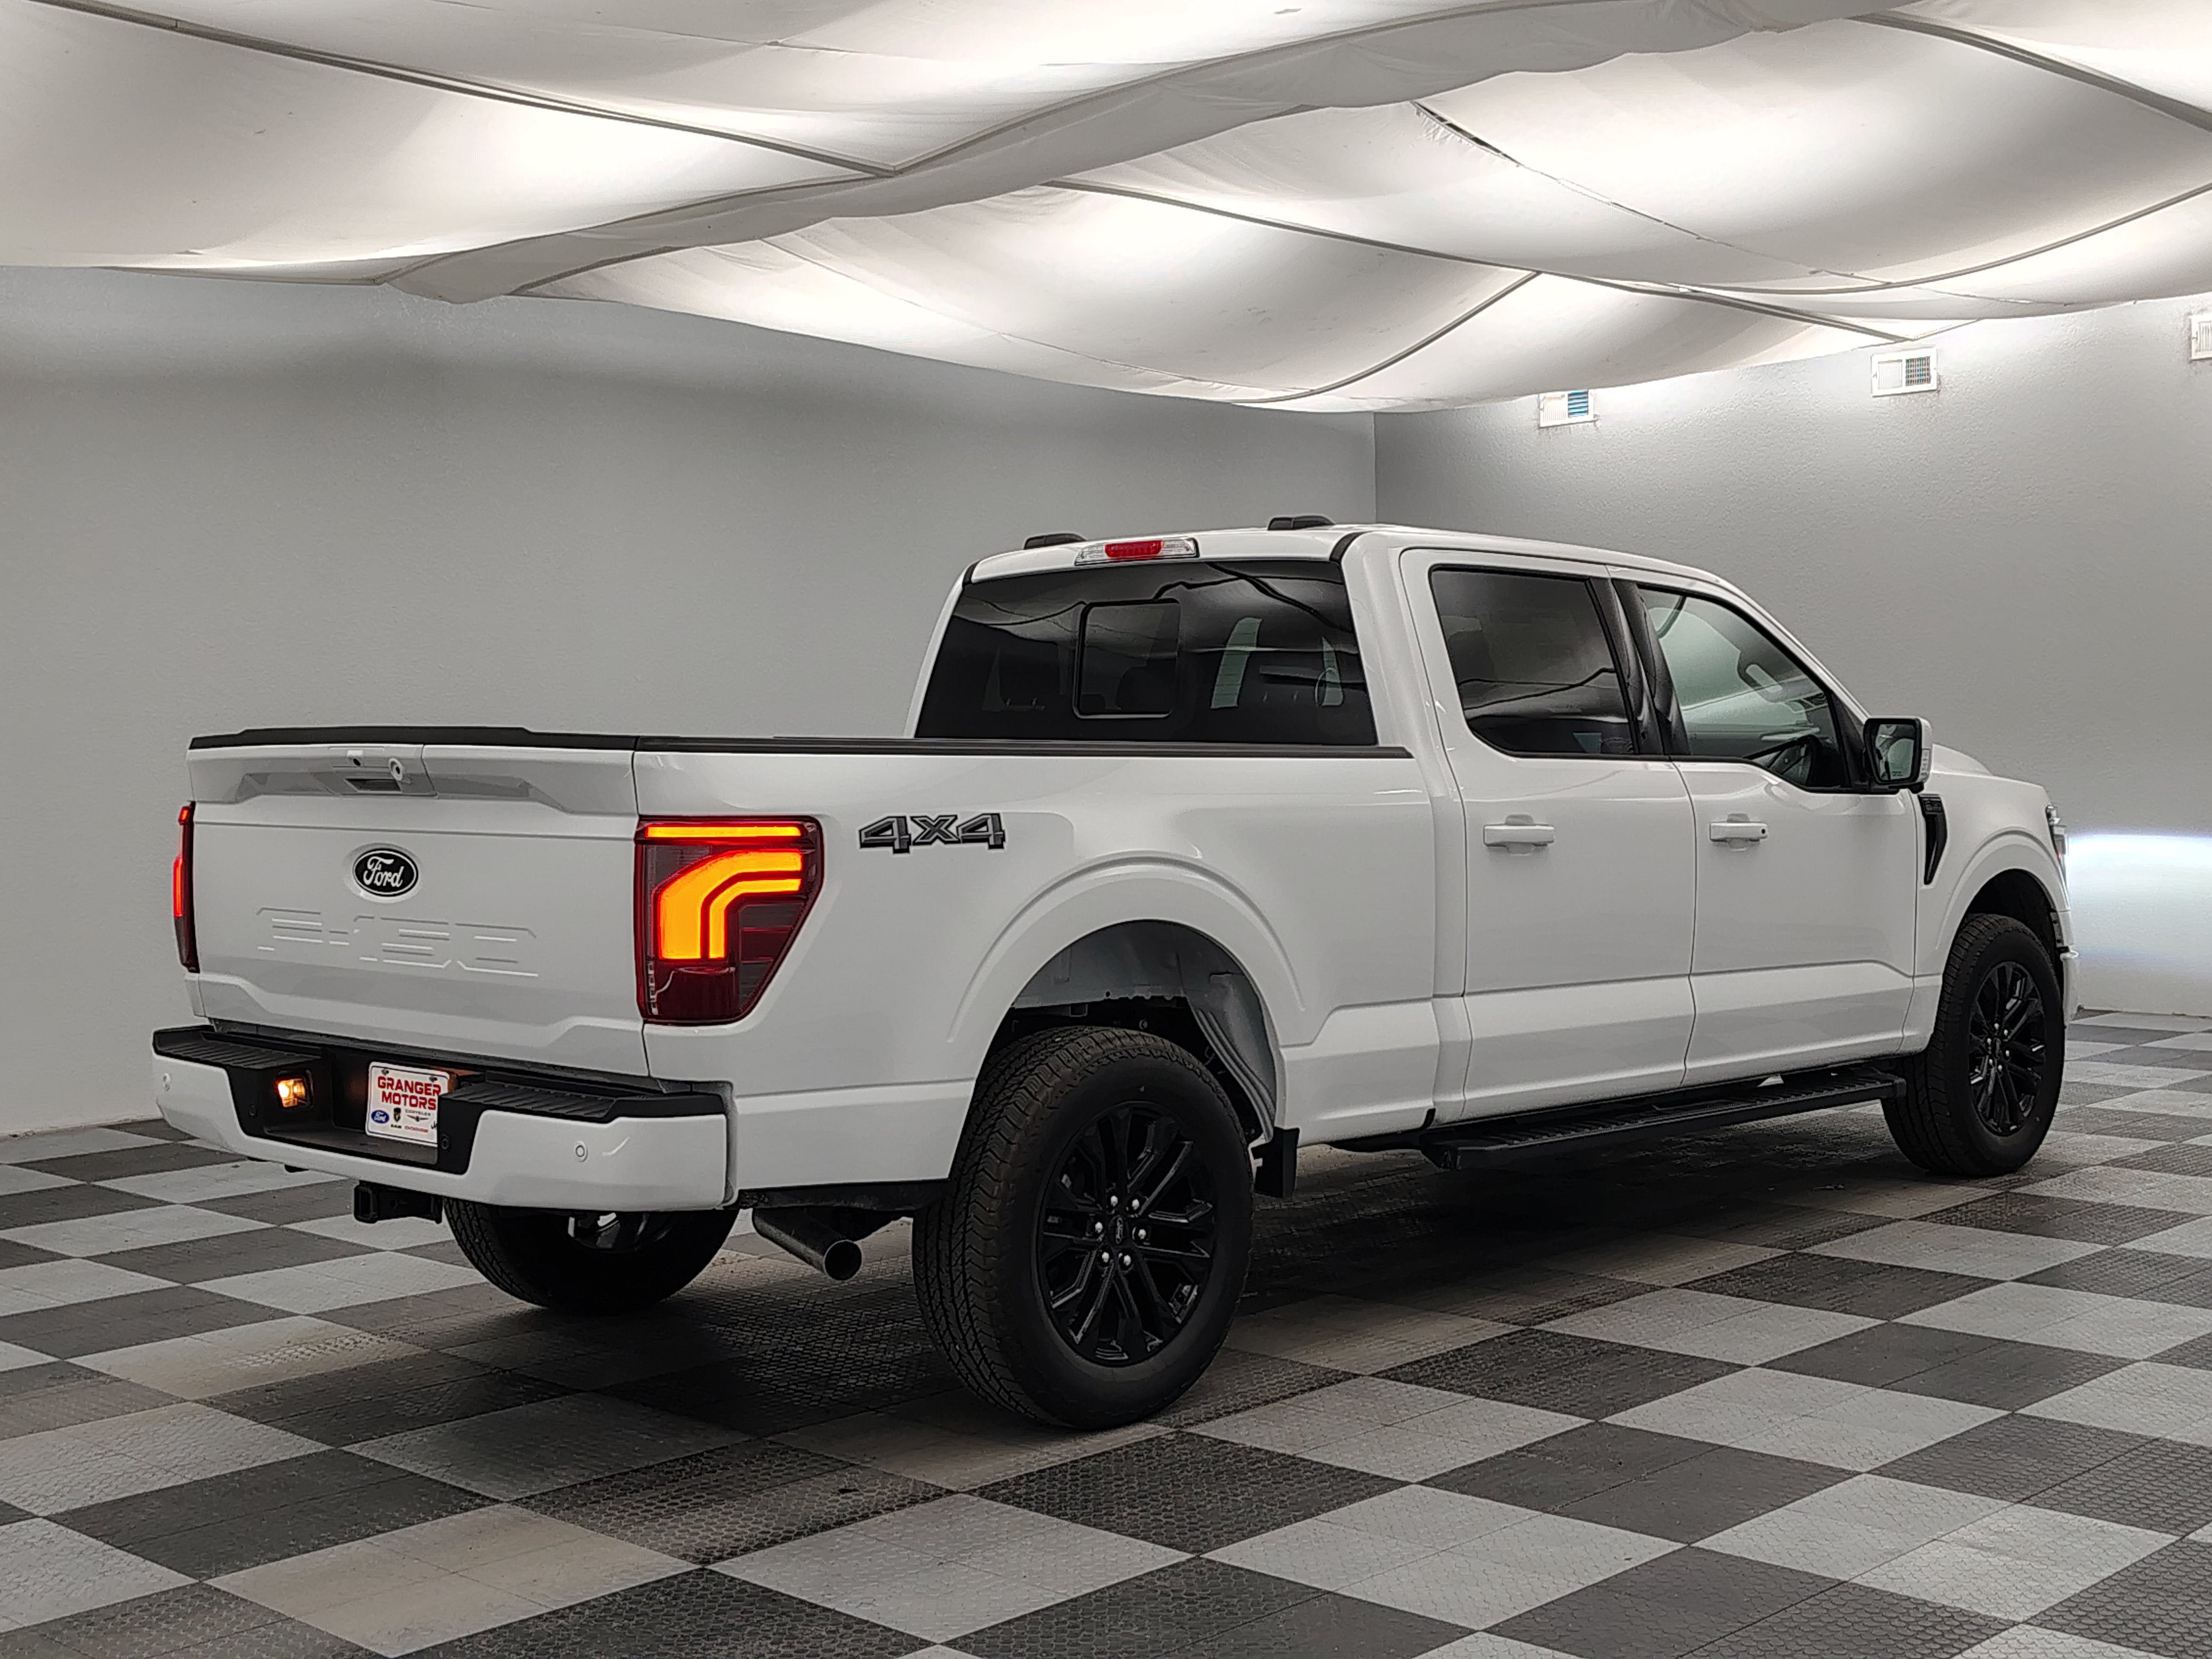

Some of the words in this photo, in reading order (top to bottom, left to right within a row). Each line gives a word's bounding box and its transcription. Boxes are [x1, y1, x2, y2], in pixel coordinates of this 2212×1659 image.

[363, 856, 404, 887] Ford
[377, 1076, 441, 1096] GRANGER
[381, 1090, 436, 1110] MOTORS
